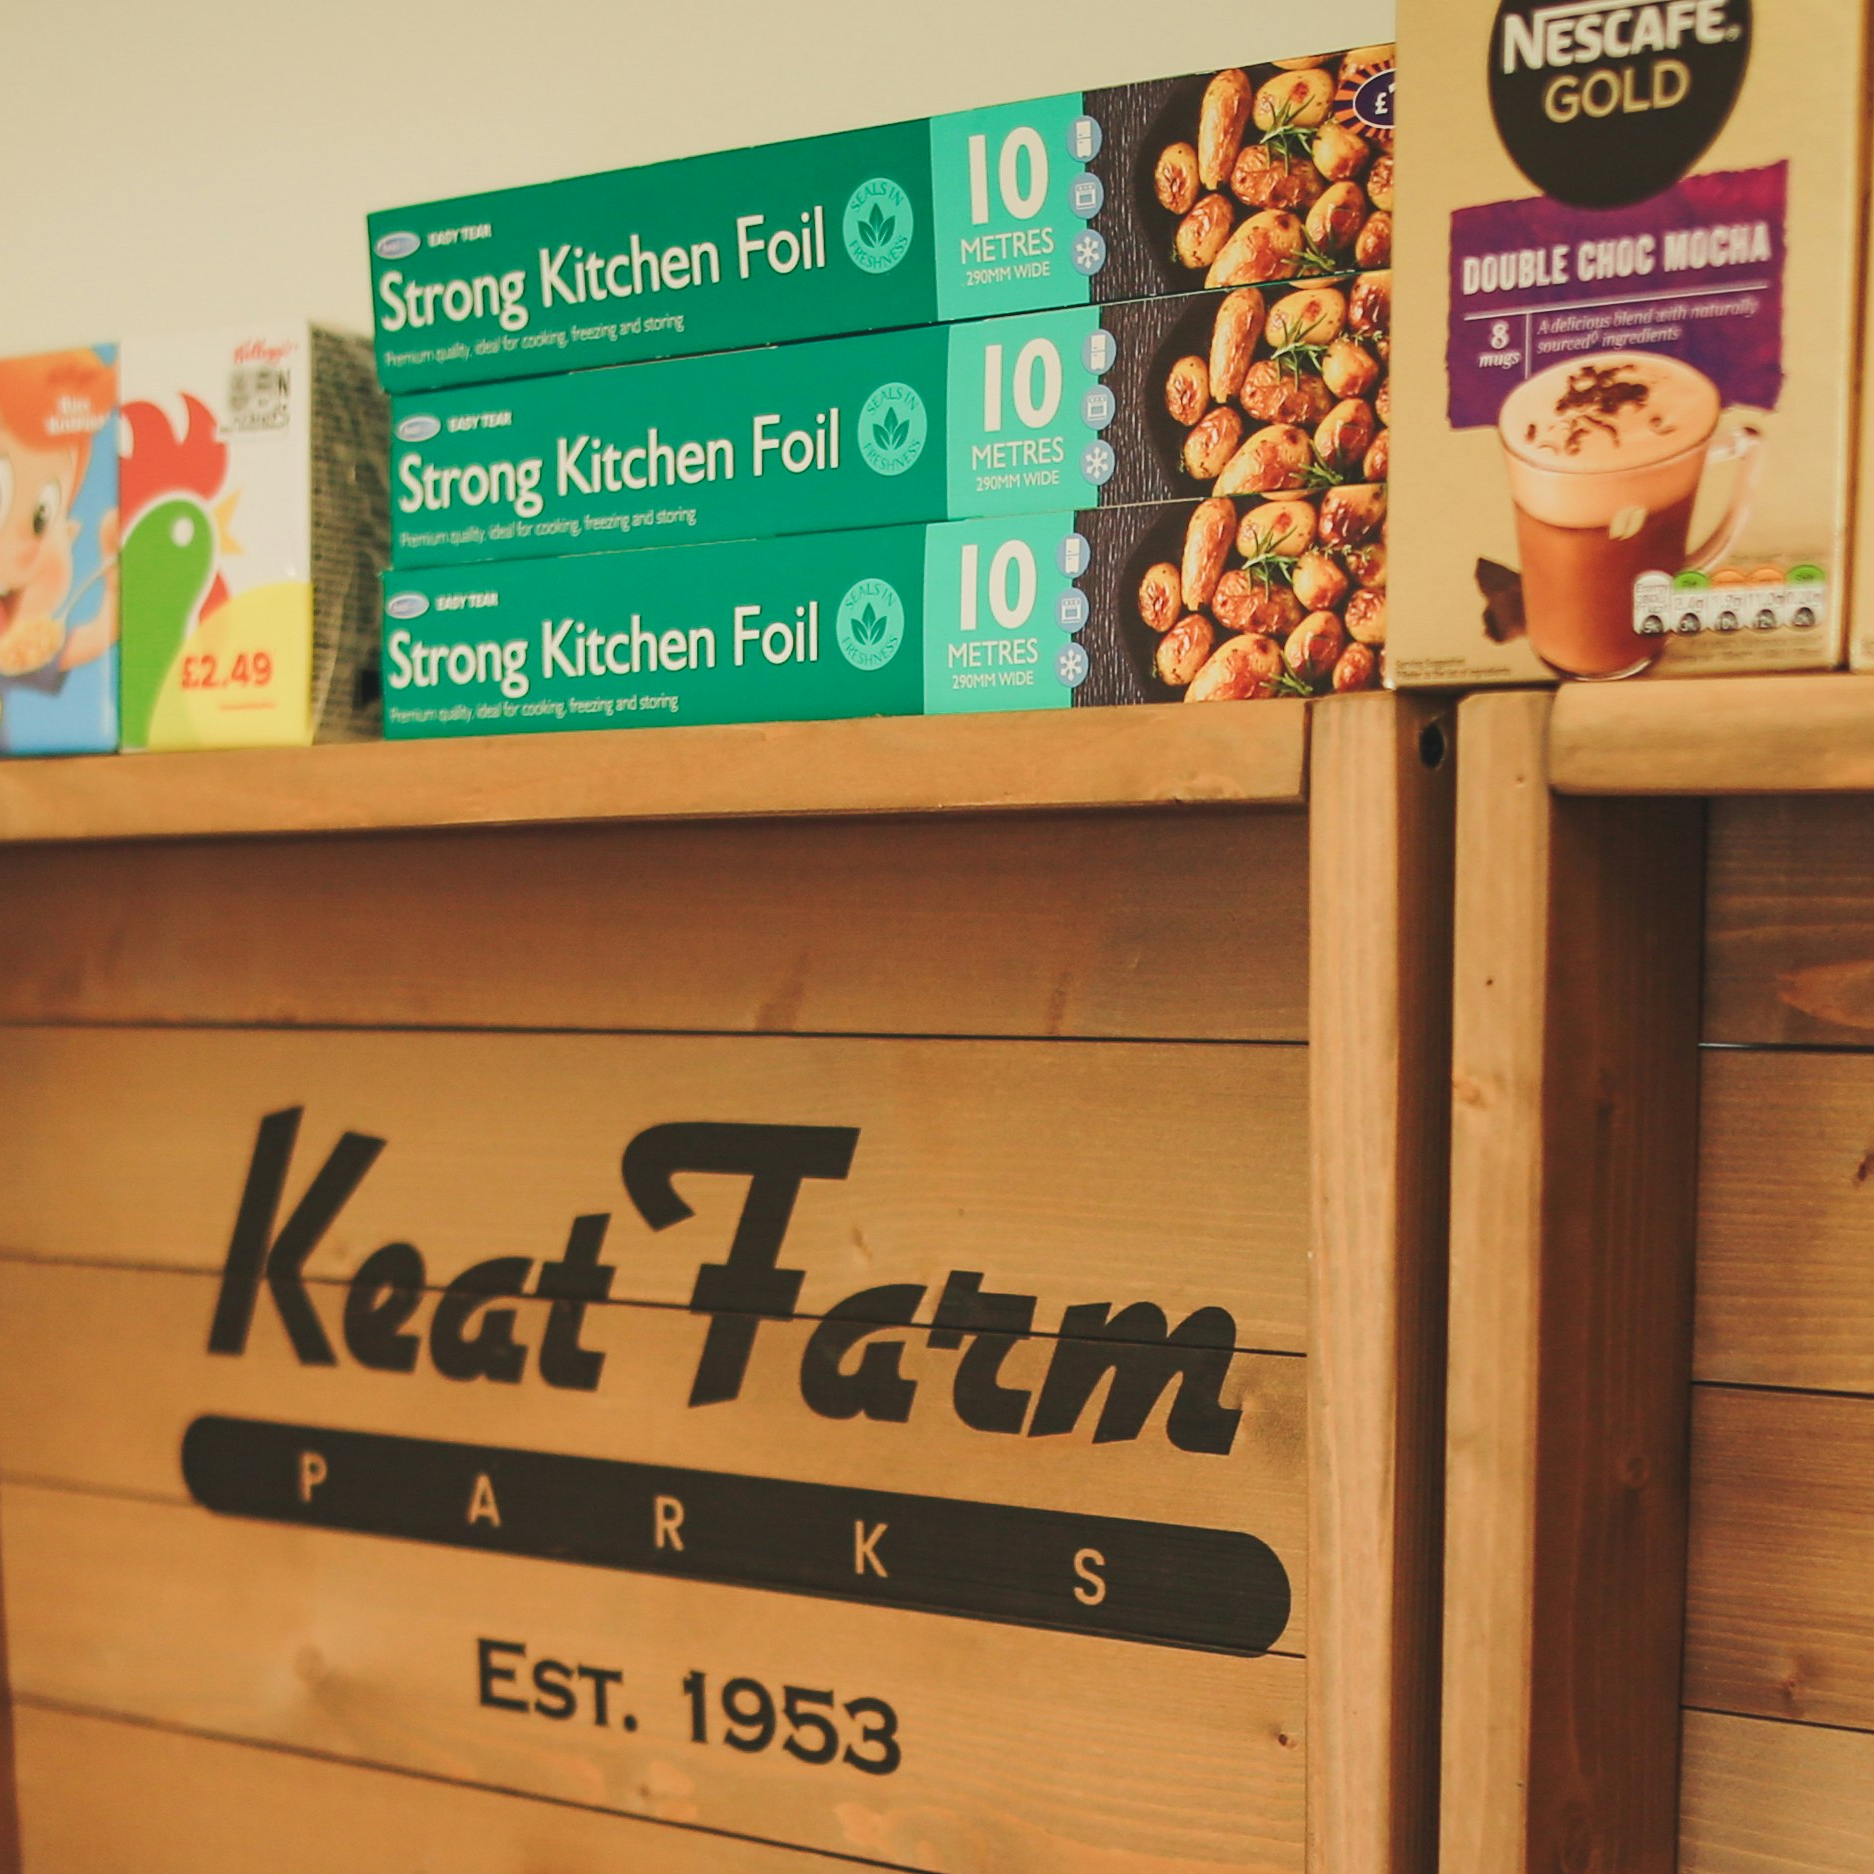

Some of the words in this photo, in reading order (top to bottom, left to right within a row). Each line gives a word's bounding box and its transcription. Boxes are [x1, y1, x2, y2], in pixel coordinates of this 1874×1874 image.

[1544, 60, 1691, 123] GOLD
[967, 126, 1050, 226] 10
[850, 182, 888, 213] SEALS
[848, 234, 908, 269] FRESHNESS
[960, 226, 1055, 265] METRES
[1462, 247, 1569, 296] DOUBLE
[1578, 235, 1656, 283] CHOC
[1663, 221, 1771, 272] MOCHA
[380, 270, 529, 331] Strong
[538, 233, 721, 309] Kitchen
[736, 205, 827, 280] Foil
[965, 264, 1012, 287] 290MM
[1013, 260, 1051, 280] WIDE
[571, 322, 618, 342] freezing
[619, 318, 642, 335] and
[643, 314, 684, 333] storing
[1551, 316, 1610, 333] delicious
[1614, 310, 1651, 327] blend
[1656, 306, 1686, 322] with
[1690, 296, 1759, 319] naturally
[1491, 320, 1510, 350] 8
[1602, 327, 1679, 349] ingredients
[1478, 350, 1521, 370] mugs
[984, 337, 1063, 433] 10
[397, 452, 544, 517] Strong
[557, 428, 735, 497] Kitchen
[752, 408, 841, 477] Foil
[971, 436, 1065, 471] METRES
[976, 474, 1021, 492] 290MM
[1023, 470, 1060, 488] WIDE
[584, 513, 630, 531] freezing
[631, 509, 654, 525] and
[656, 506, 697, 525] storing
[960, 539, 1037, 631] 10
[388, 630, 528, 698] Strong
[541, 614, 717, 678] Kitchen
[733, 601, 819, 667] Foil
[947, 637, 1038, 668] METRES
[181, 652, 274, 691] £2.49
[951, 673, 997, 690] 290MM
[998, 669, 1035, 686] WIDE
[569, 697, 614, 716] freezing
[615, 695, 638, 711] and
[639, 693, 679, 712] storing
[207, 1105, 616, 1393] Keat
[621, 1121, 1244, 1456] Farm
[299, 1449, 1109, 1606] PARKS
[682, 1669, 900, 1777] 1953
